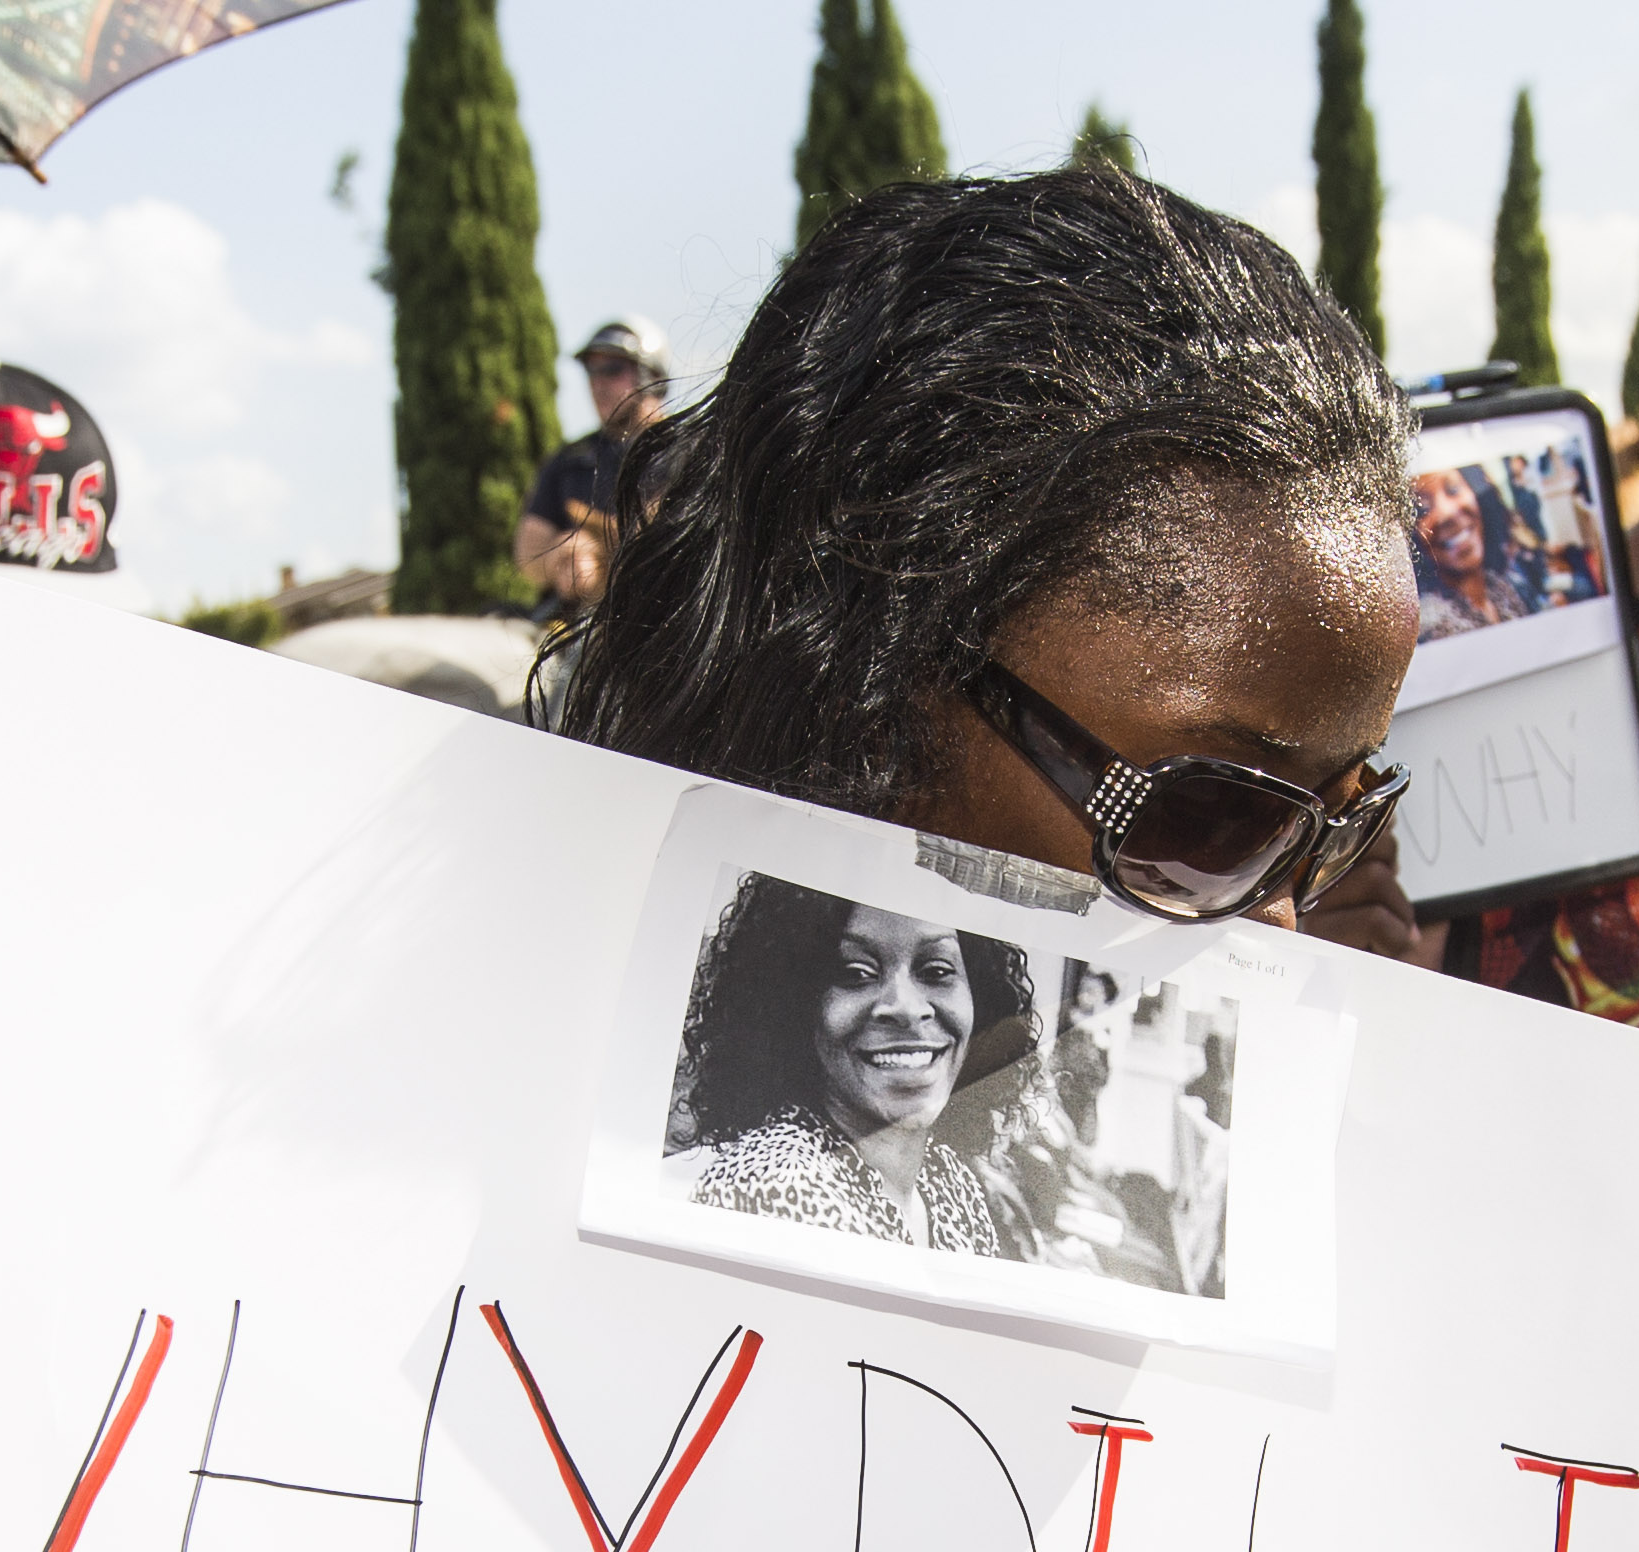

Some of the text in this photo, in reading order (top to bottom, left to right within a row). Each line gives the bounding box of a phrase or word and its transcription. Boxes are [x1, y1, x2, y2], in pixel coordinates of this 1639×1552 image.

[1378, 711, 1578, 868] WHY
[1228, 952, 1253, 970] Page
[1265, 964, 1278, 975] of
